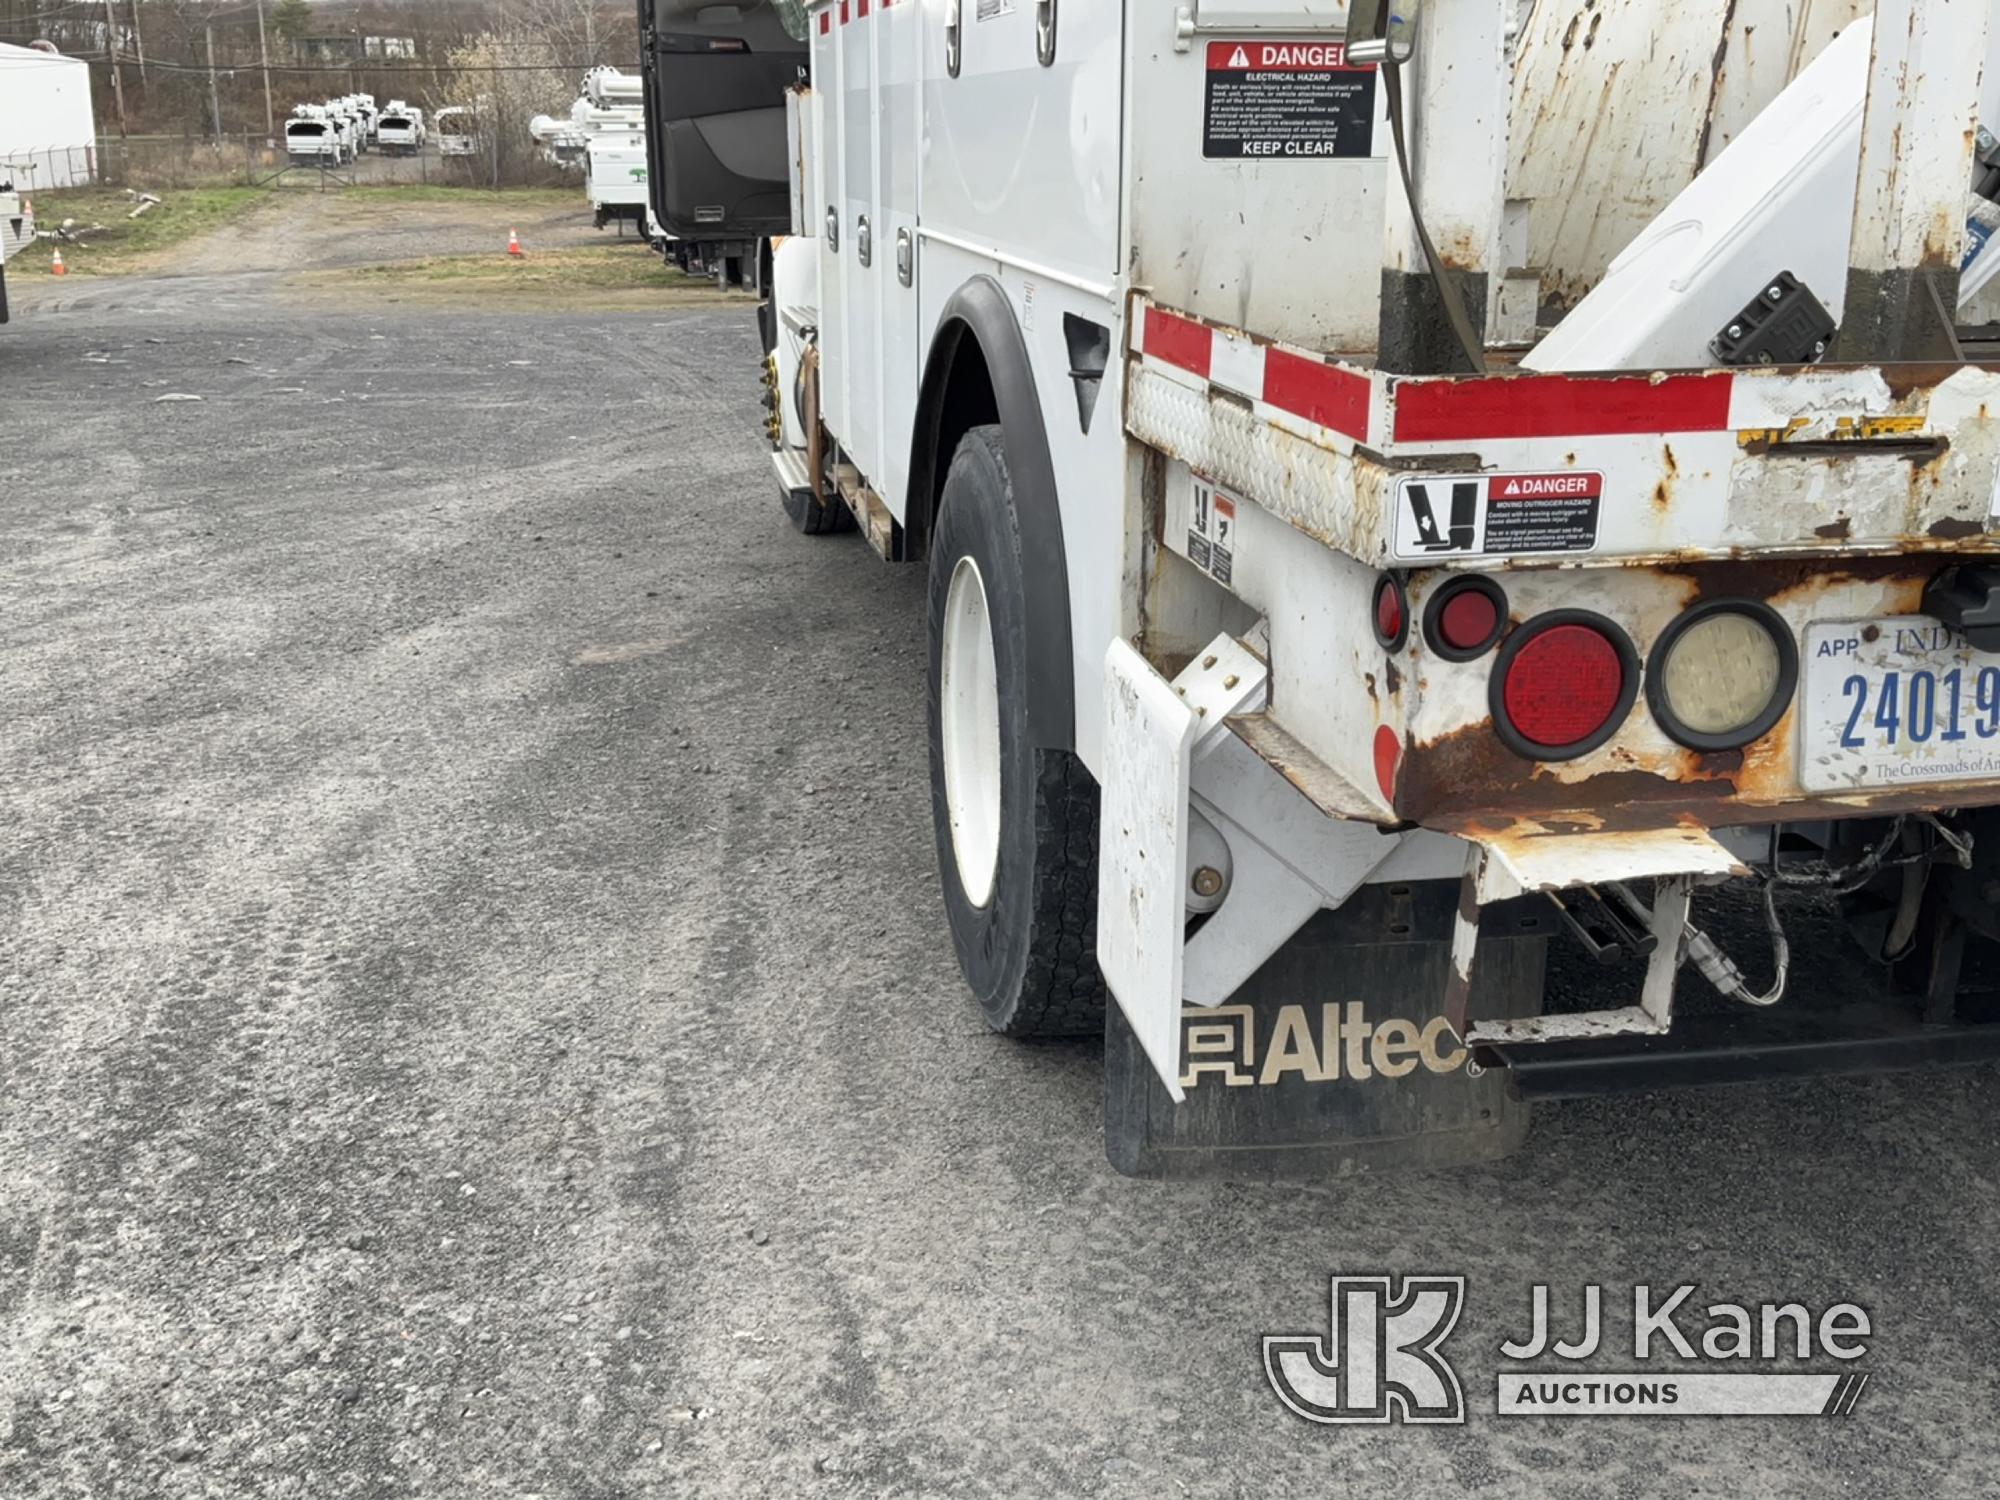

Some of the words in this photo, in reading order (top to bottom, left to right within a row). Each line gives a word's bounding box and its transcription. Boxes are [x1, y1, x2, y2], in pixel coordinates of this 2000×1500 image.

[1262, 46, 1344, 66] DANGE
[1246, 72, 1295, 81] ELECTRICAL
[1298, 72, 1331, 82] HAZARD
[1242, 142, 1282, 155] KEEP
[1284, 142, 1334, 154] CLEAR
[1522, 478, 1588, 494] DANGER
[1817, 638, 1859, 658] APP
[1840, 666, 2000, 748] 24019
[1876, 764, 1900, 778] The
[1900, 759, 1969, 776] Crossroads
[1971, 757, 1982, 772] of
[1258, 1000, 1467, 1085] Altec
